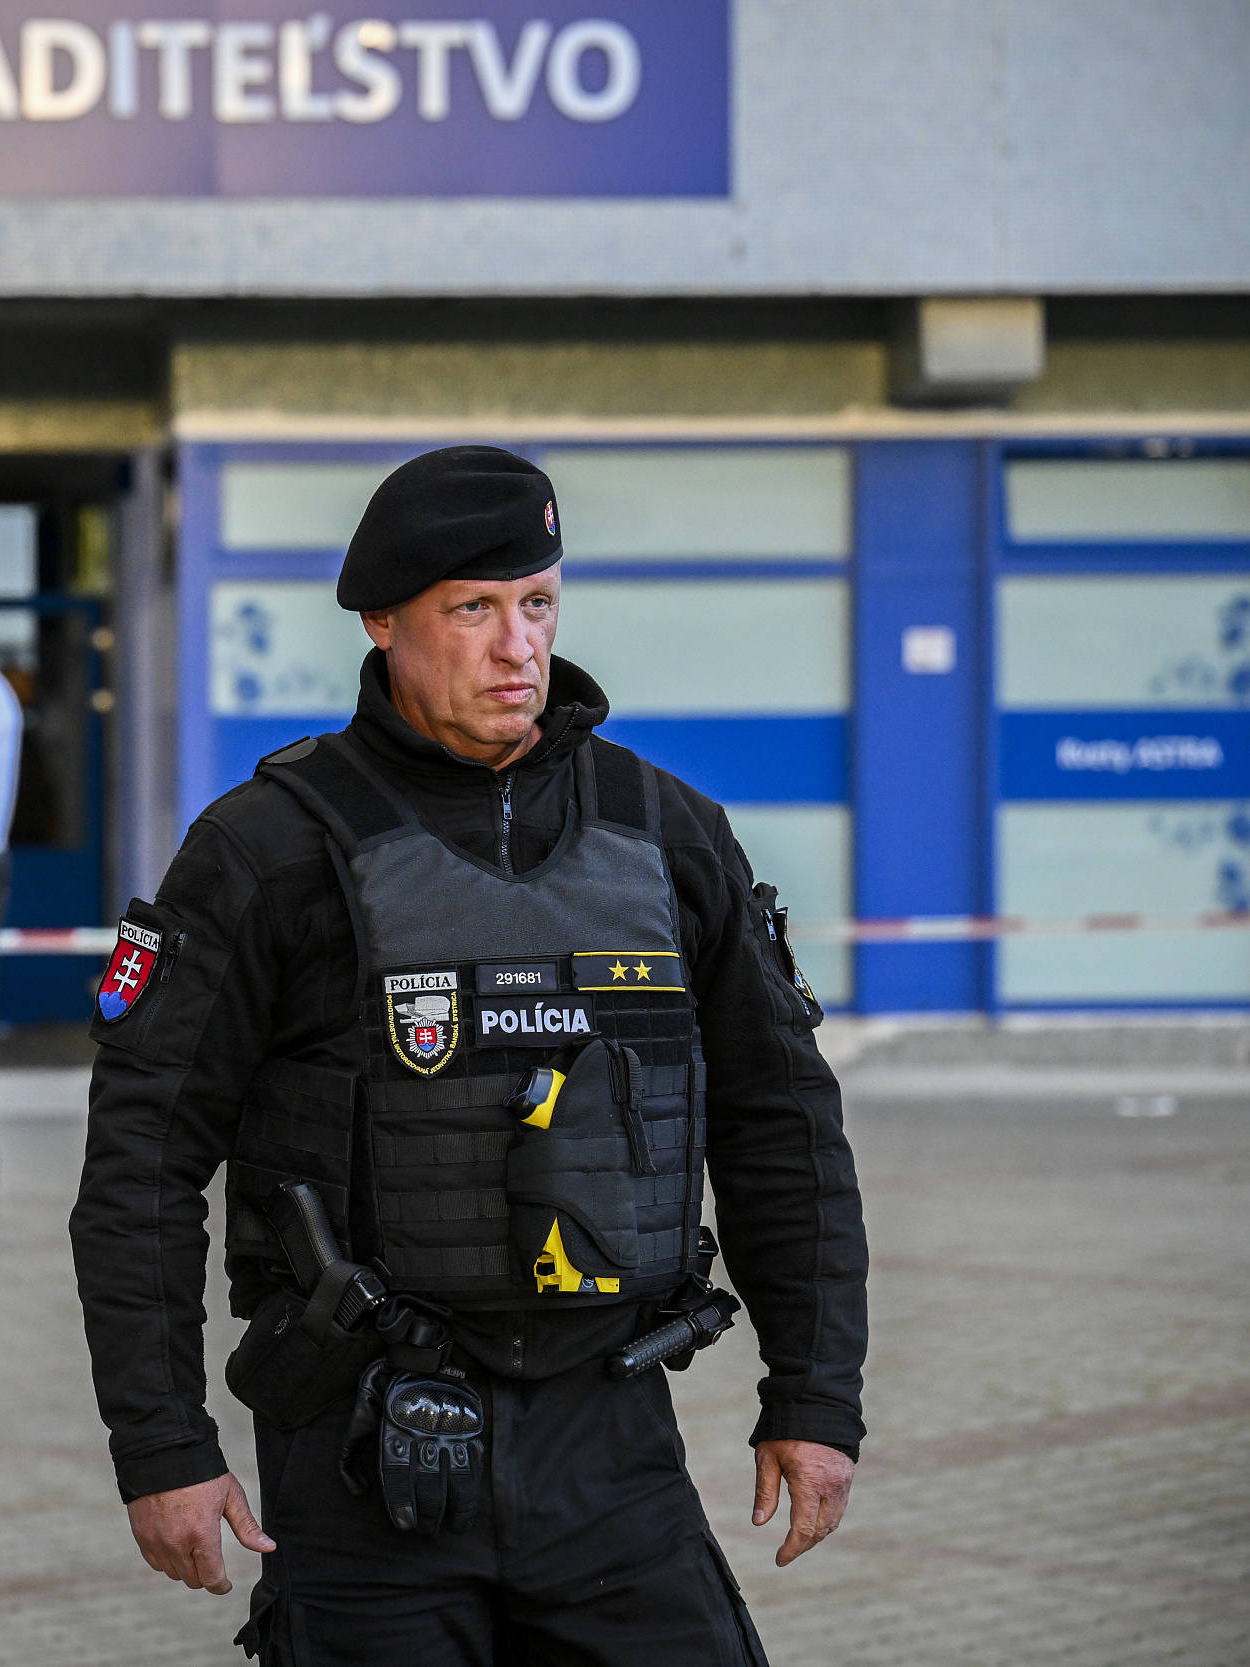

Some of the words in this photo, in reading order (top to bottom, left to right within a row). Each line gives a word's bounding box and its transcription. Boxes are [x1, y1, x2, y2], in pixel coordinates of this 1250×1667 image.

[121, 924, 159, 949] POLÍCIA
[390, 975, 452, 991] POLÍCIA
[496, 971, 542, 986] 291681
[481, 1002, 590, 1035] POLÍCIA
